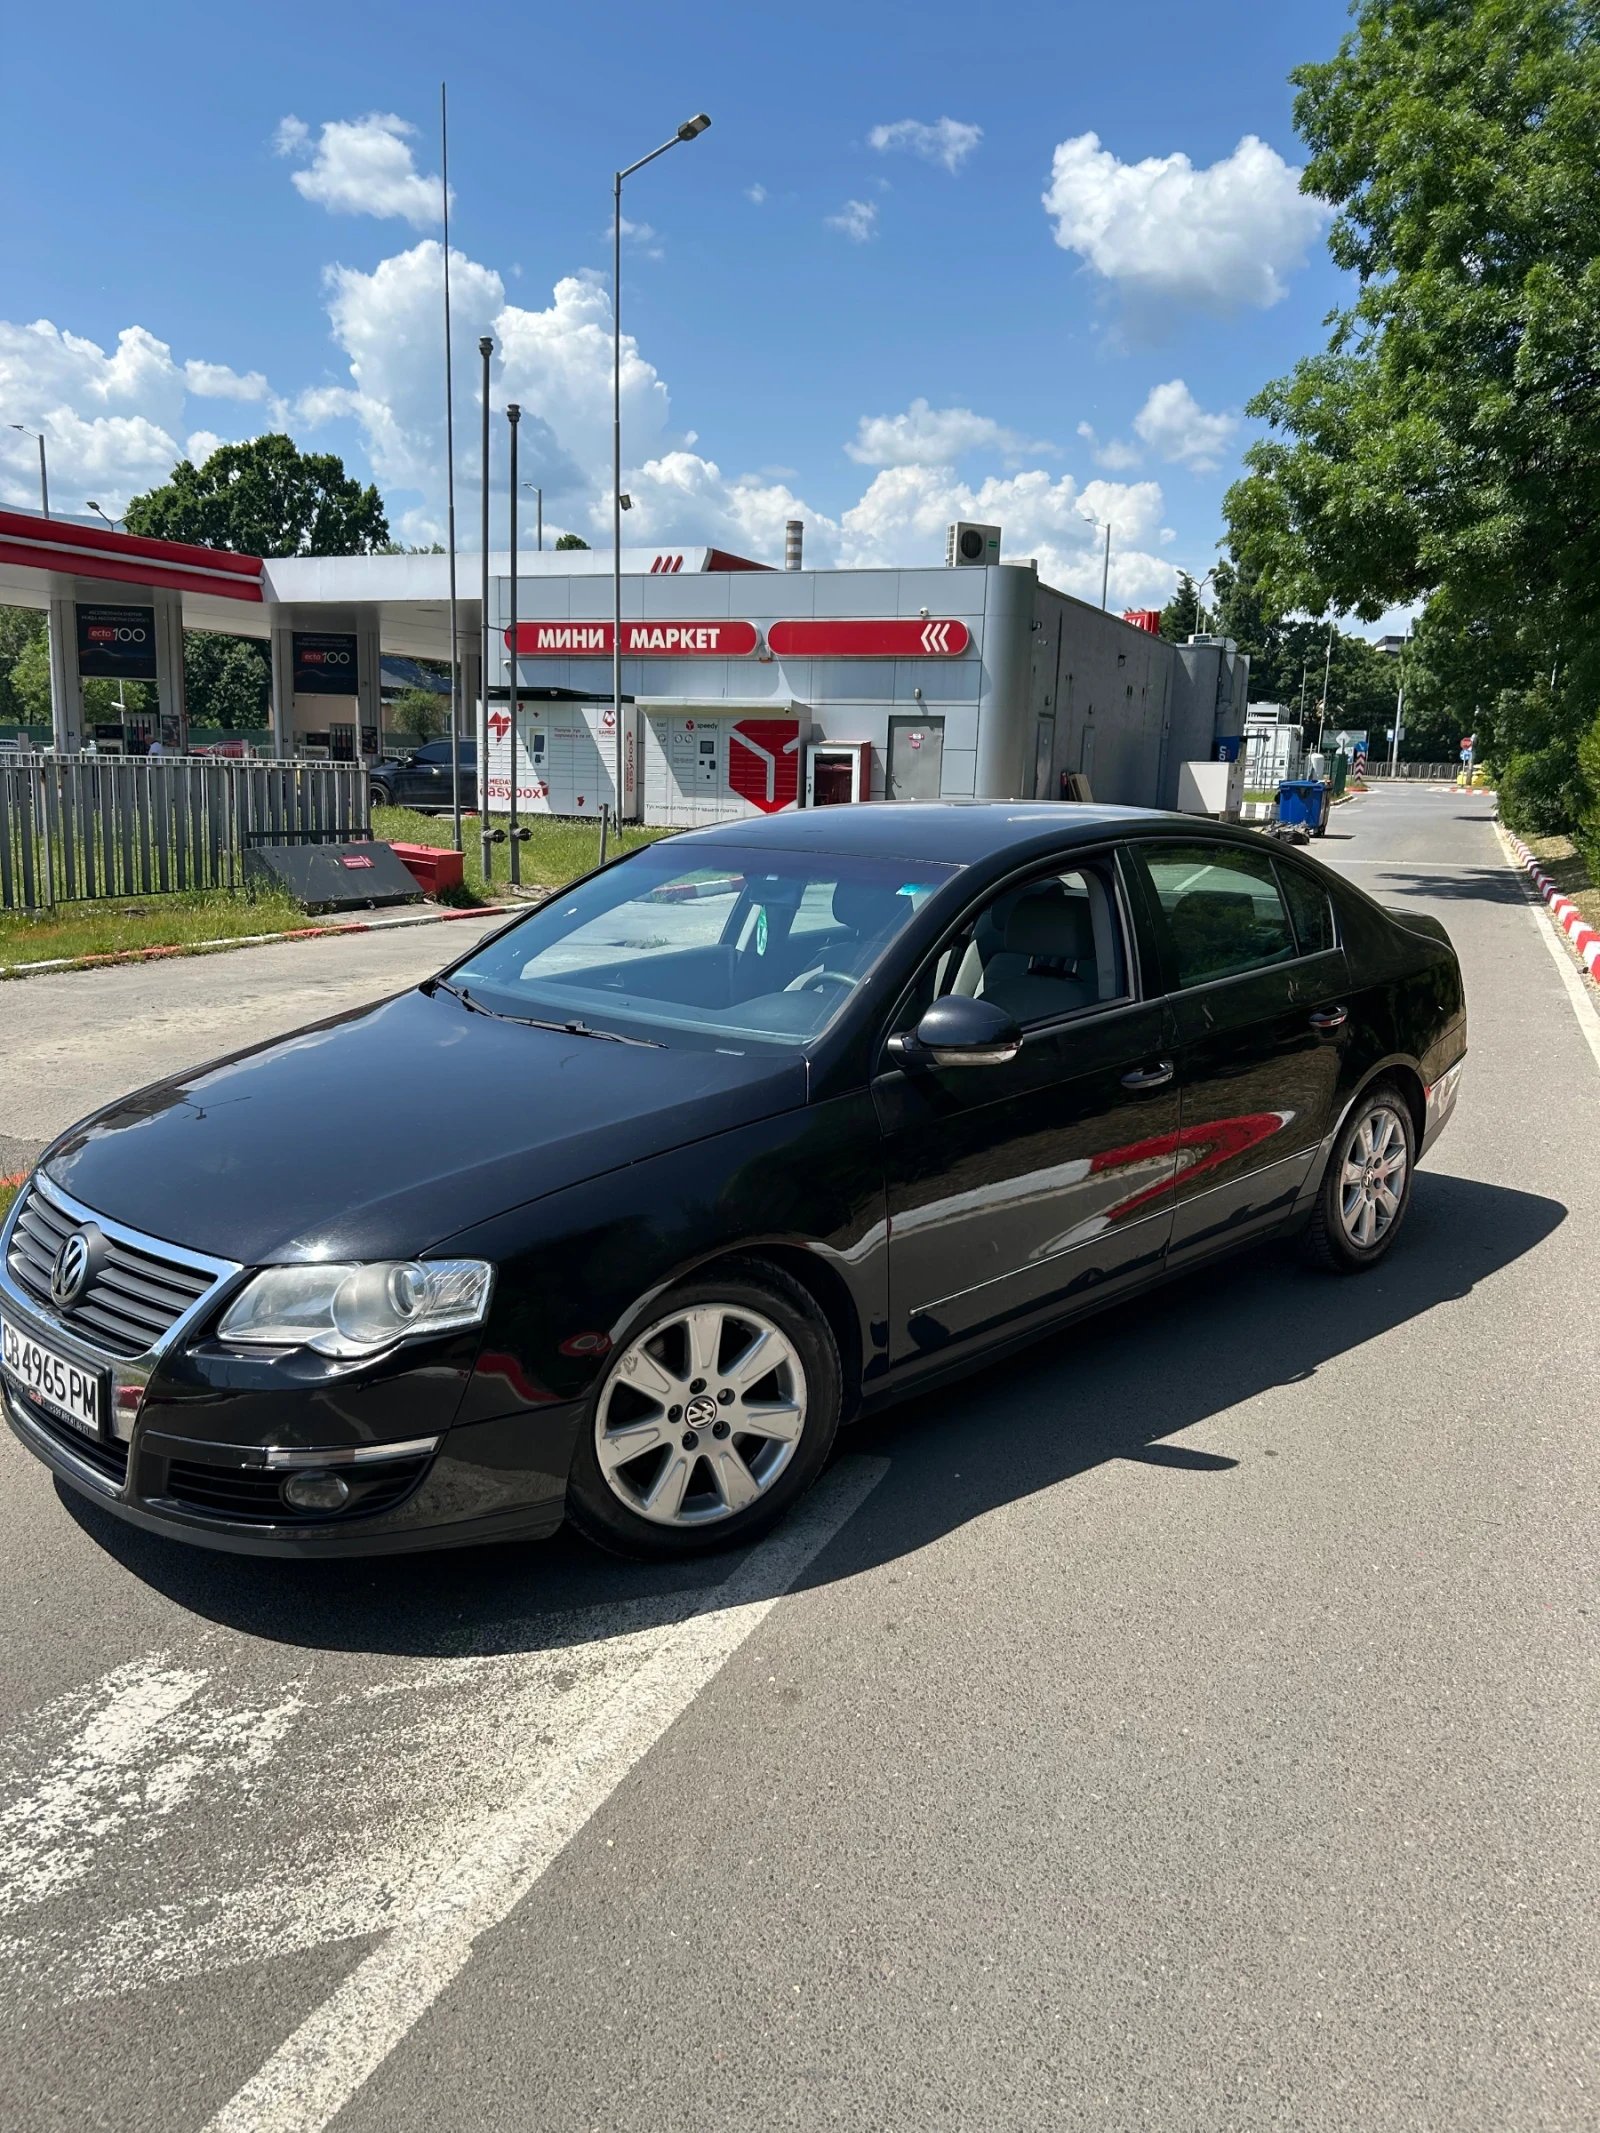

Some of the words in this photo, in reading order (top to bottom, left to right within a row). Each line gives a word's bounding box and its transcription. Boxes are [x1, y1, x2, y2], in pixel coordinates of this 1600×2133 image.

[537, 628, 604, 648] МИНИ
[629, 628, 720, 648] МАРКЕТ
[697, 722, 718, 730] speedy
[480, 786, 540, 800] asyox
[22, 1342, 66, 1402] 4965
[69, 1368, 97, 1423] PM
